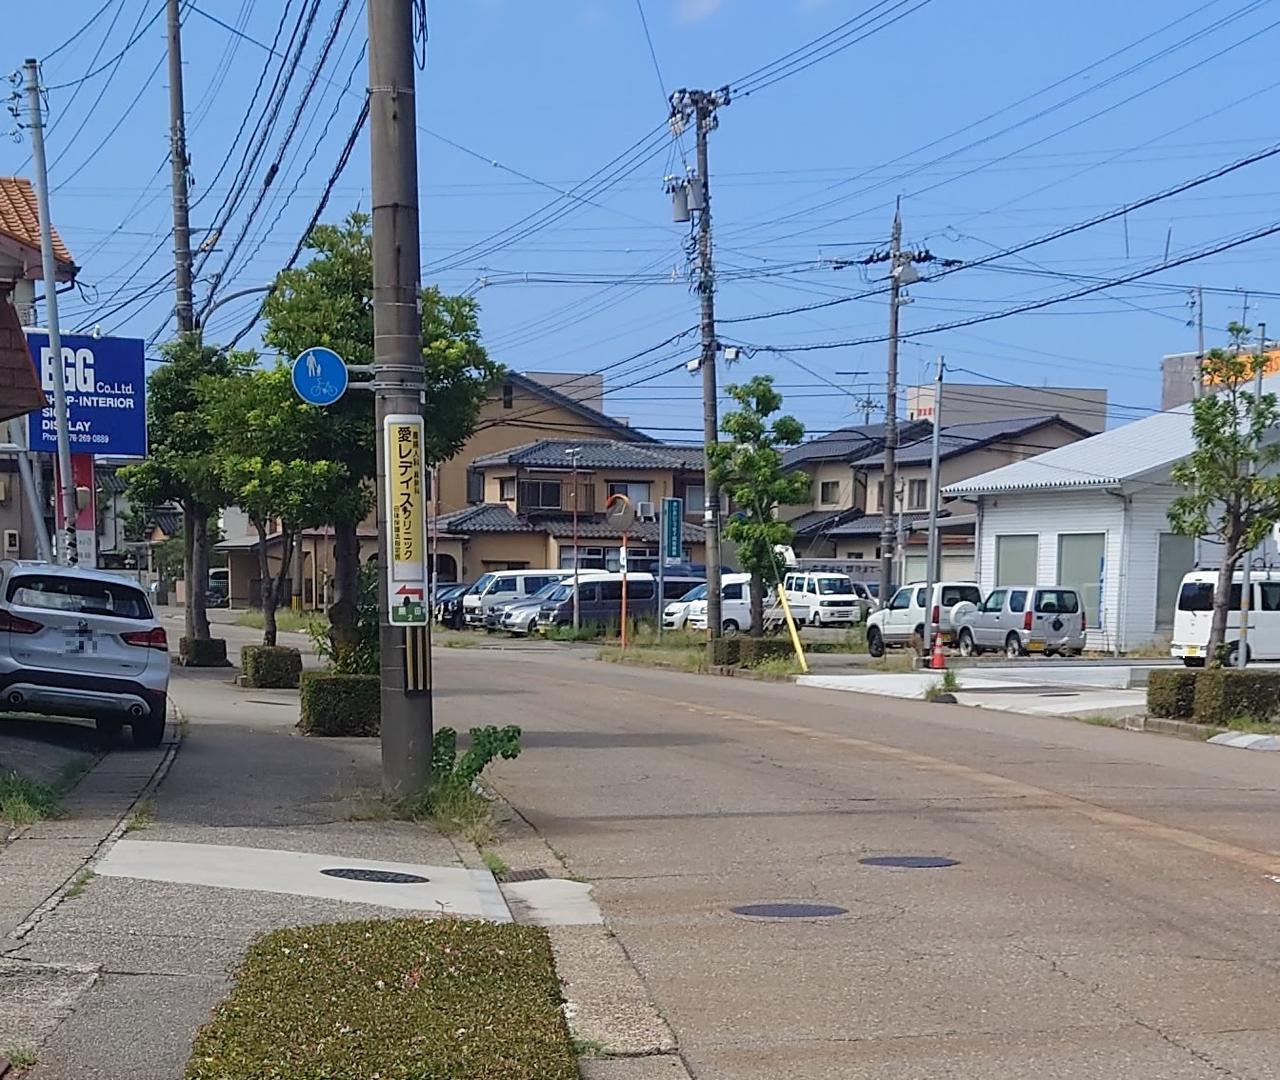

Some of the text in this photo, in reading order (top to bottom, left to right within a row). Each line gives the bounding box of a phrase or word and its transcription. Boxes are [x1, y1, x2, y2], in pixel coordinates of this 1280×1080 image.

[45, 394, 134, 408] HP-INTERIOR
[42, 420, 91, 432] DISLAY
[407, 614, 414, 622] 2
